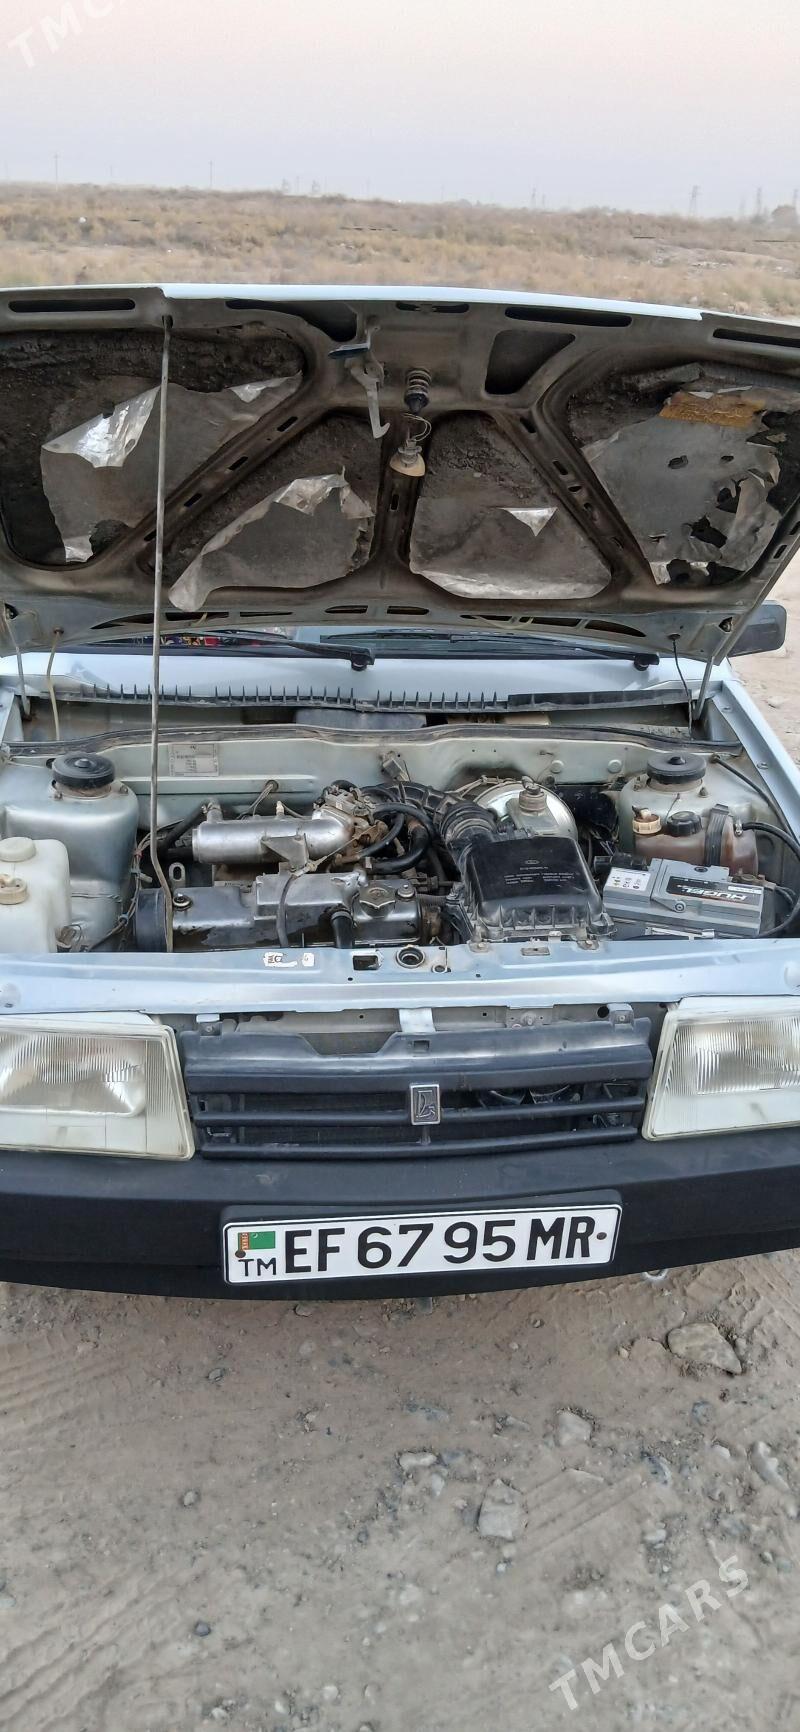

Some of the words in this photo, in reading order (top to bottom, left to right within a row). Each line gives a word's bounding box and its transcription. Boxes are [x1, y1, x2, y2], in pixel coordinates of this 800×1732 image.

[284, 1228, 345, 1274] EF
[526, 1215, 596, 1261] MR
[238, 1257, 277, 1277] TM
